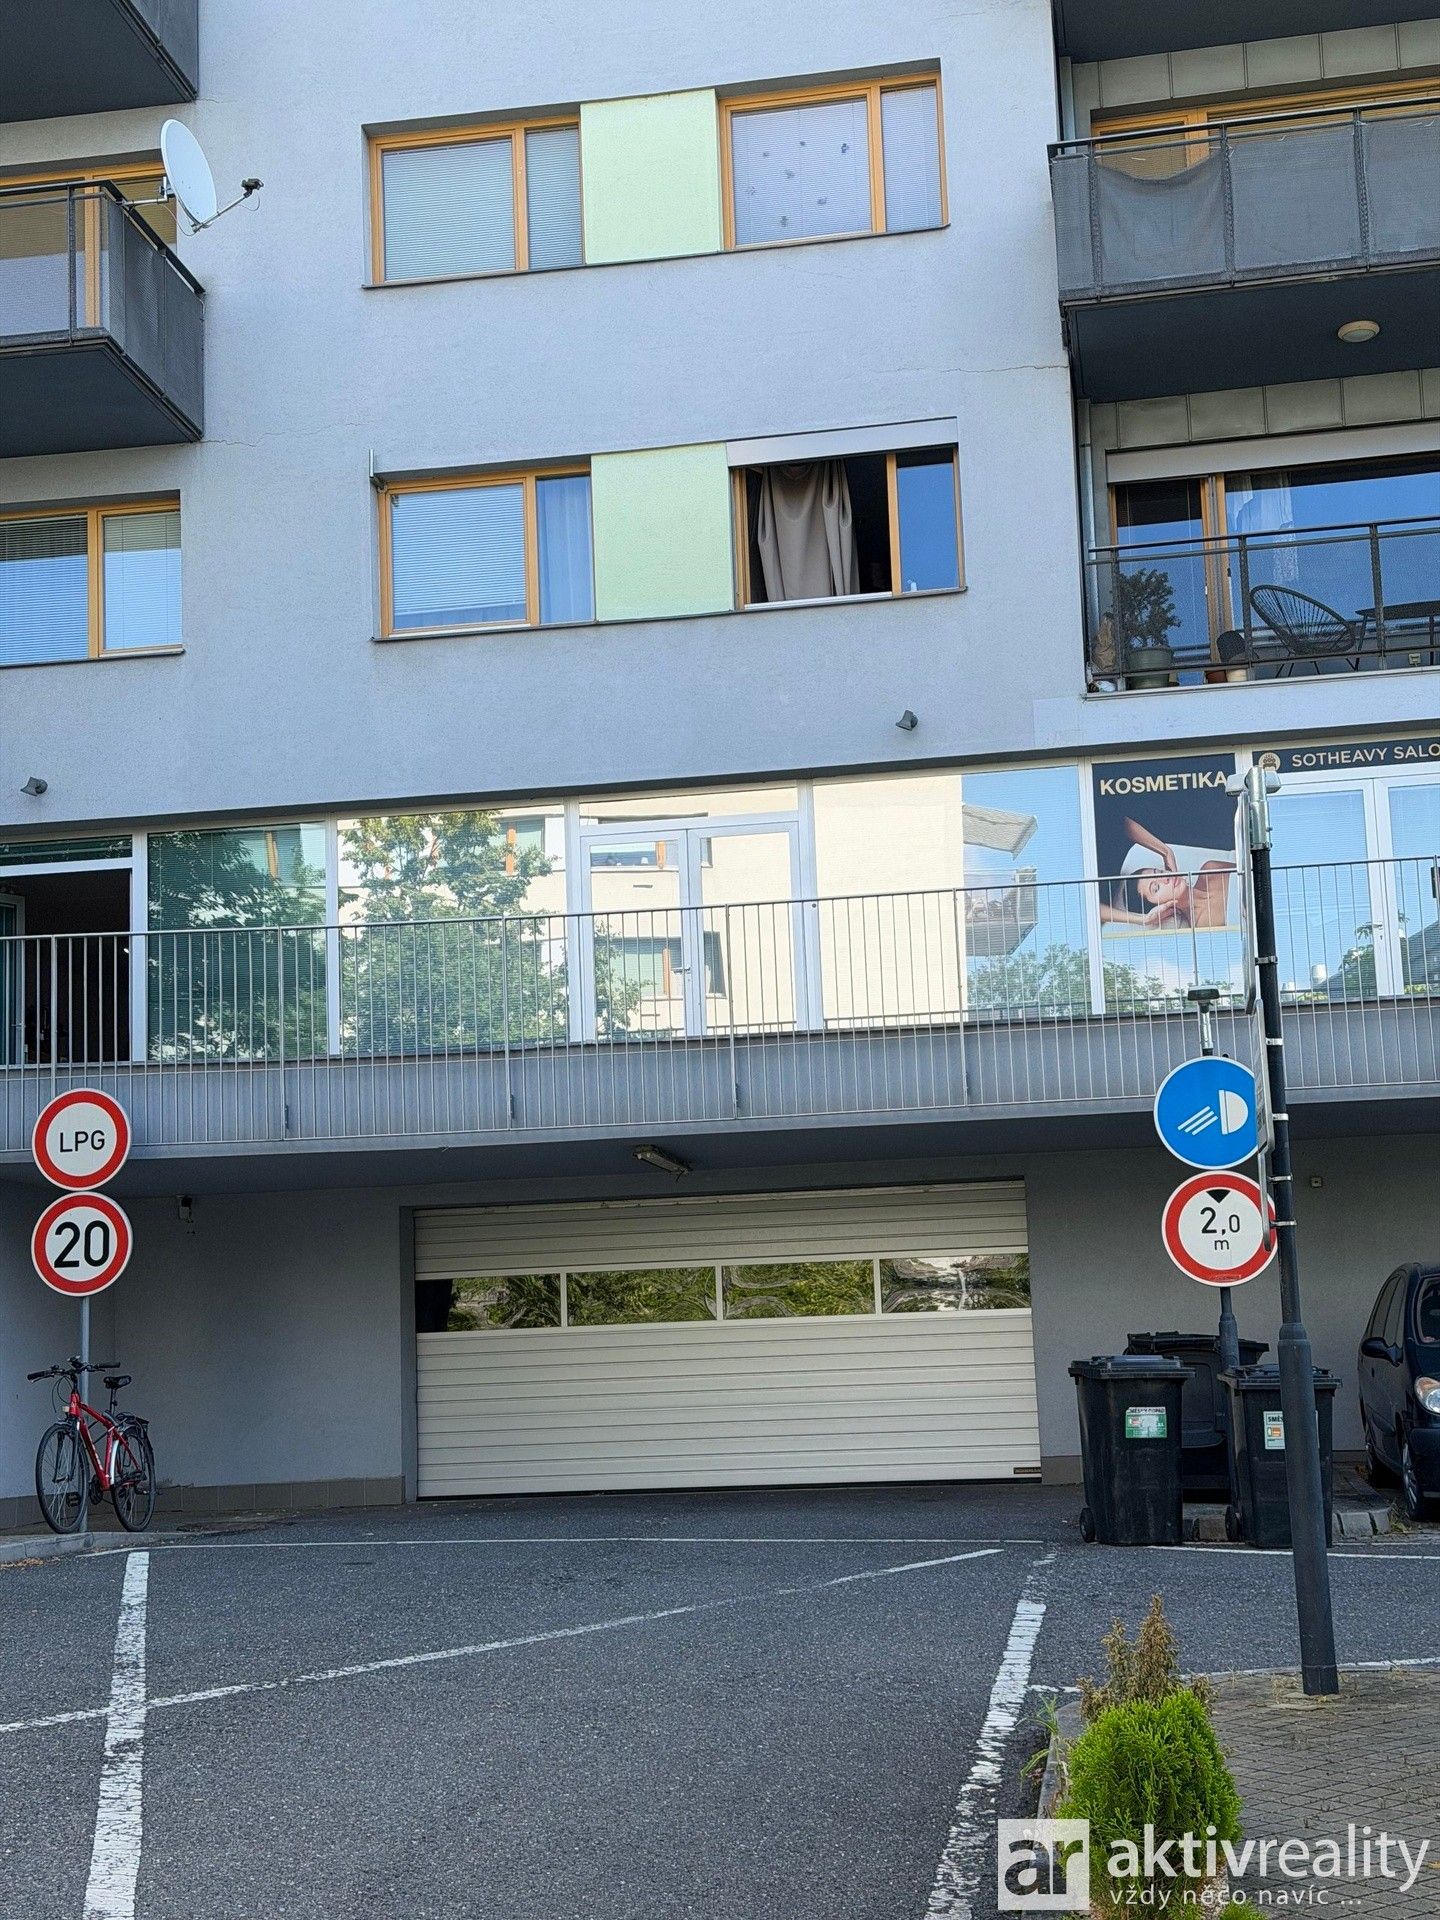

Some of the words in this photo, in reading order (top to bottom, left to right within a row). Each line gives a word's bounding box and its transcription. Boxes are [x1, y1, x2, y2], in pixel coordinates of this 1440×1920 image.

[1292, 748, 1388, 767] SOTHEAVY
[1394, 743, 1440, 759] SALO
[1100, 770, 1227, 795] KOSMETIKA
[59, 1130, 105, 1152] LPG
[1200, 1207, 1240, 1236] 2,0
[54, 1220, 110, 1268] 20
[1214, 1239, 1230, 1250] m
